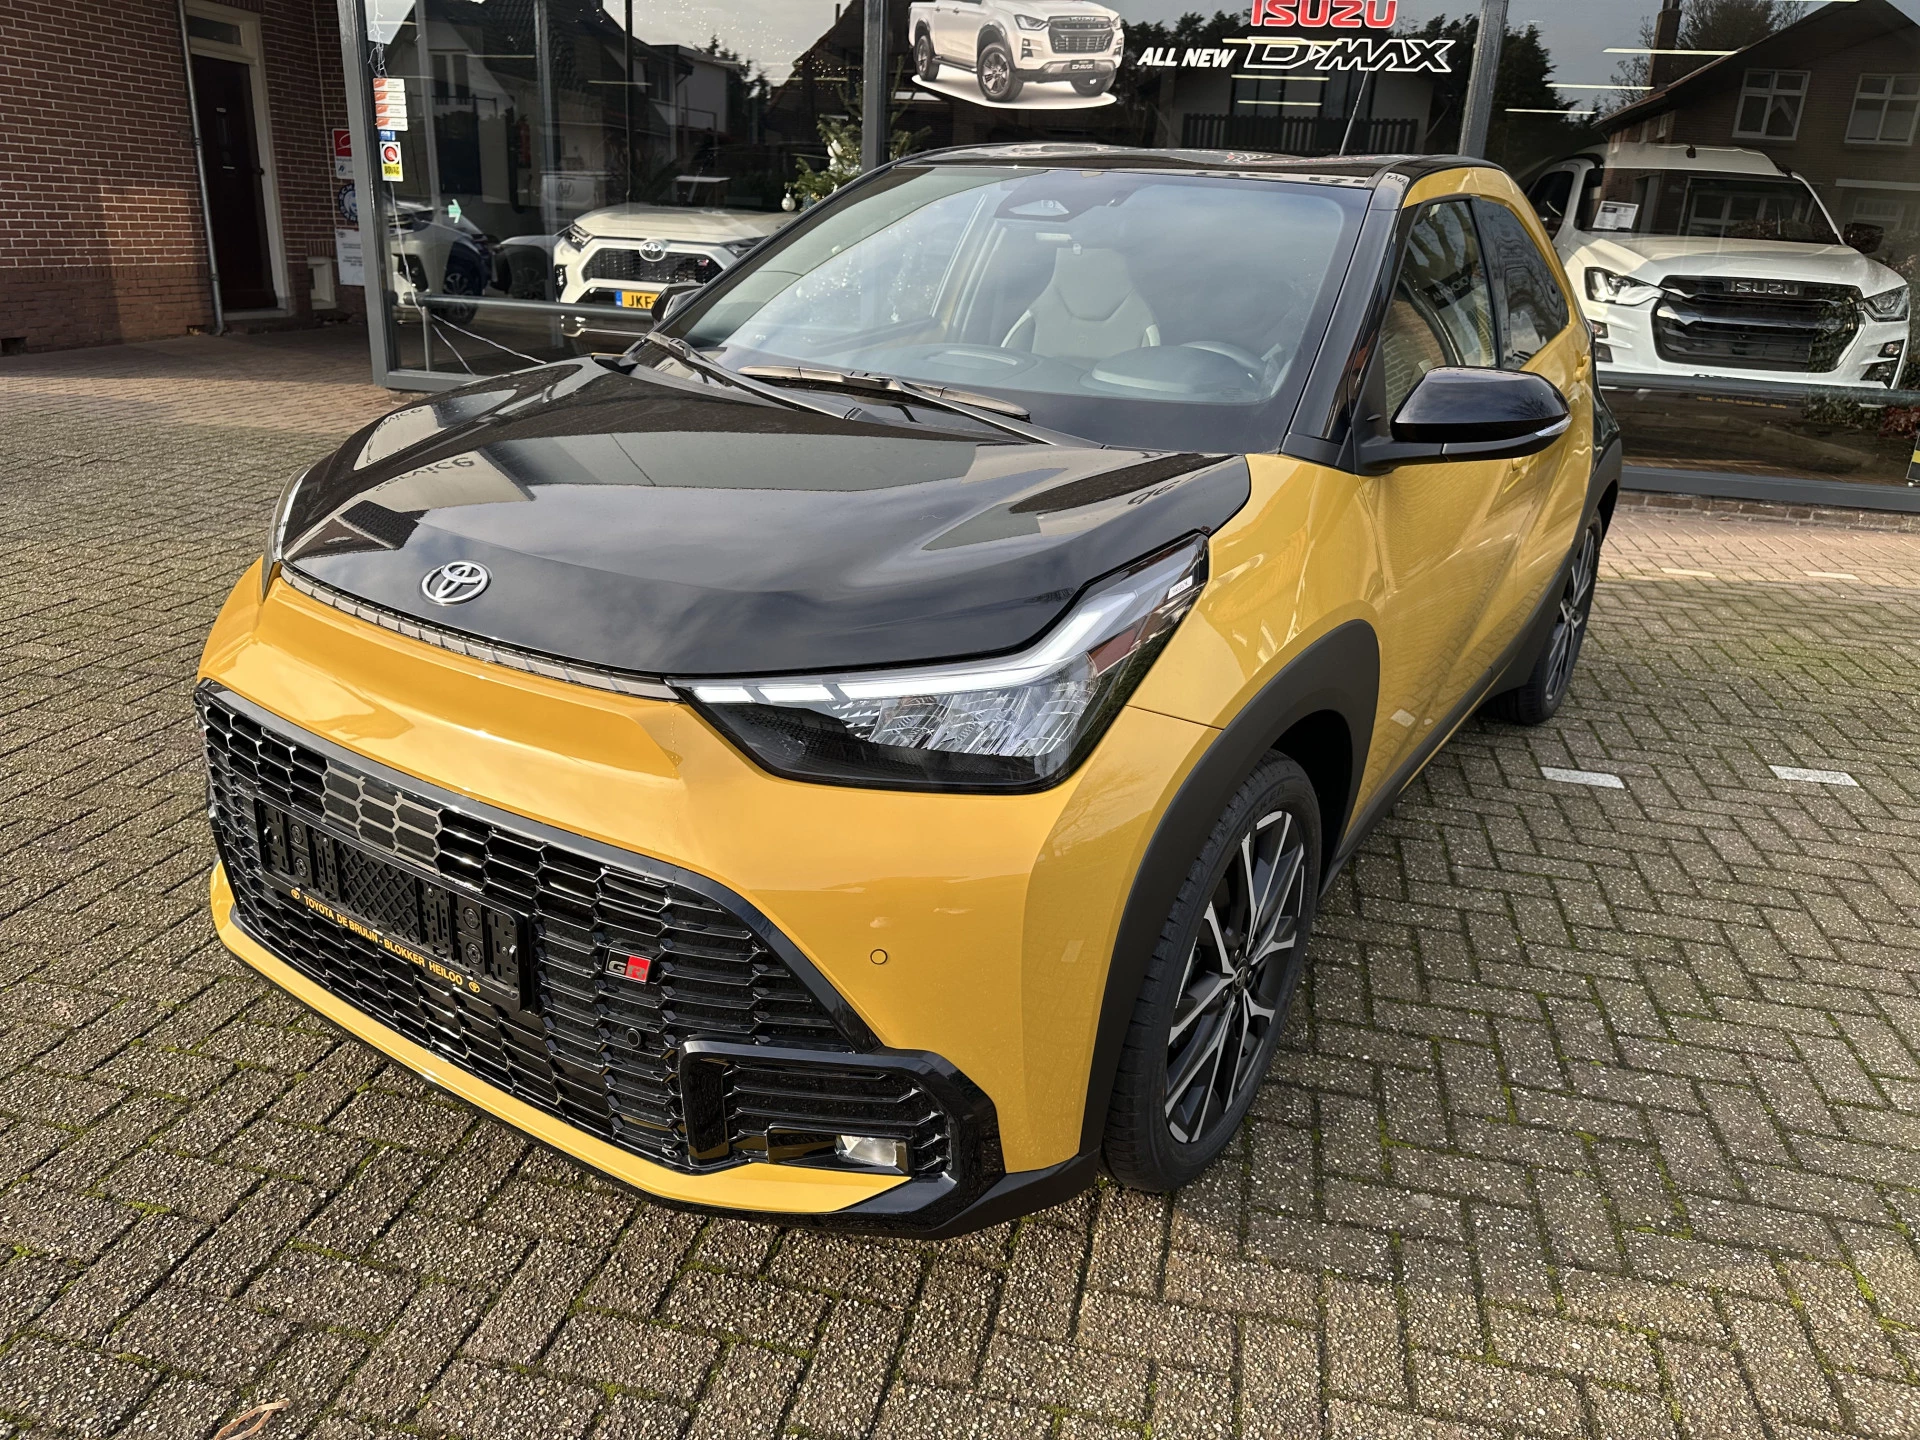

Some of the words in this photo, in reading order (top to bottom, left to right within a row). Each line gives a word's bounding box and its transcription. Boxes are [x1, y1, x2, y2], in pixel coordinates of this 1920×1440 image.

[1250, 0, 1398, 29] ISUZU
[1137, 47, 1177, 67] ALL
[1182, 48, 1236, 68] NEW
[1730, 281, 1799, 296] ISUZU
[303, 895, 335, 920] TOYOTA
[336, 913, 349, 927] DE
[348, 919, 378, 944] BRUIJN
[383, 938, 426, 968] BLOKKER
[428, 960, 463, 986] HEILOO
[608, 960, 646, 980] GR
